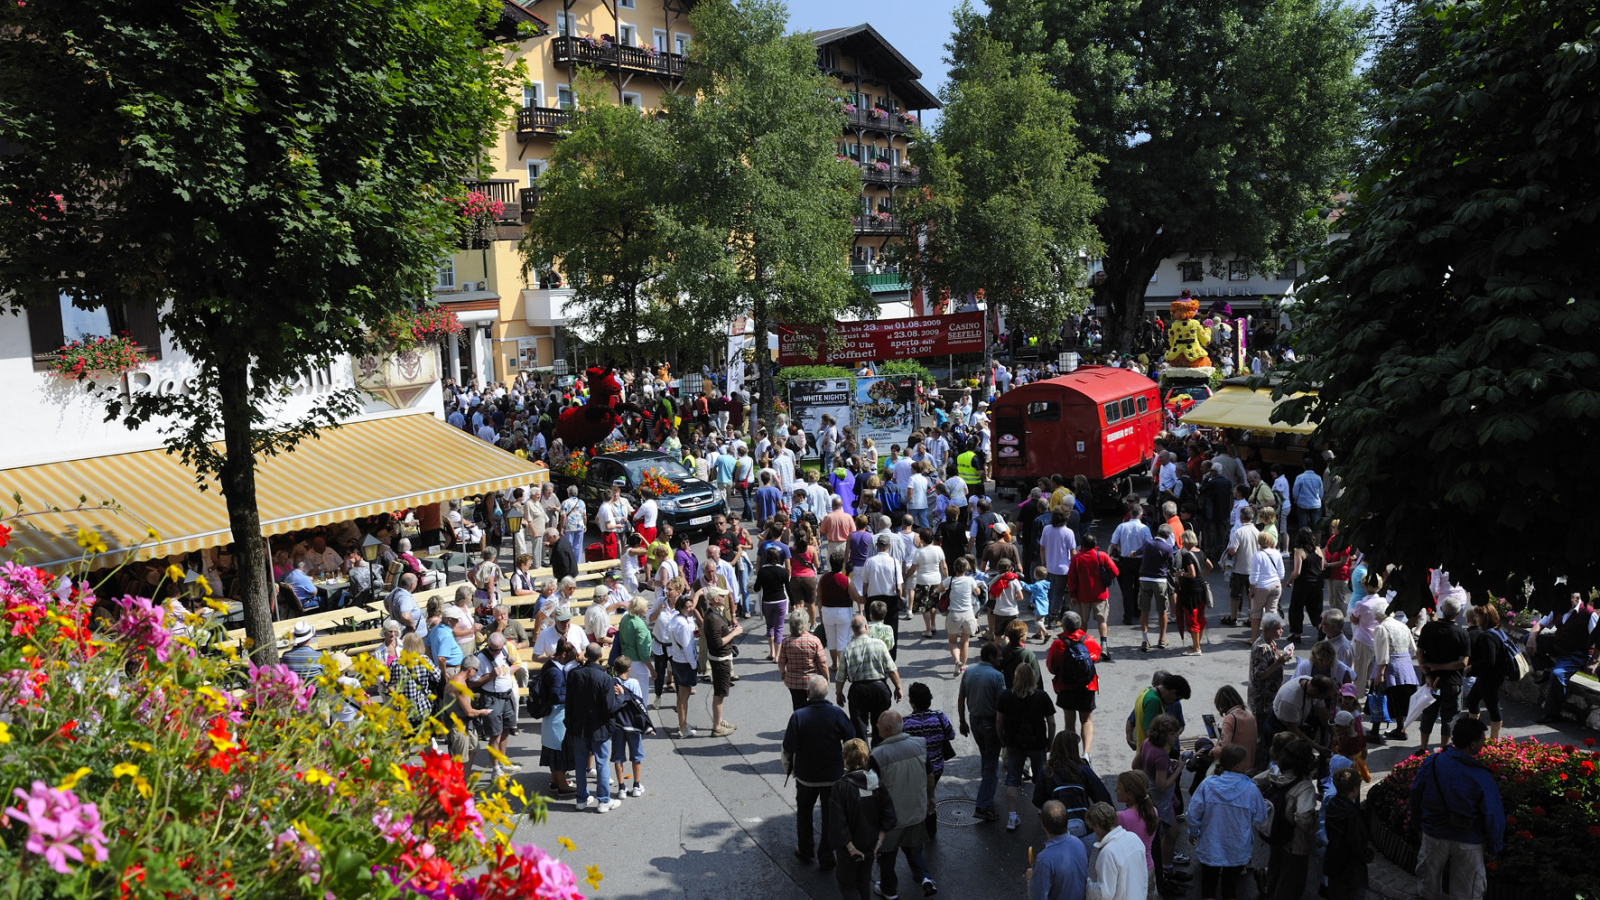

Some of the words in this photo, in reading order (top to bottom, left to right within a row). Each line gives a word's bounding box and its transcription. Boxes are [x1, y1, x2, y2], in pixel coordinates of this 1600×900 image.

[1180, 287, 1252, 297] AILER
[895, 319, 942, 330] 01.08.2009
[948, 322, 980, 332] CASINO
[894, 329, 940, 339] 23.08.2009
[948, 330, 982, 339] SEEFELD
[890, 338, 920, 348] aperto
[826, 349, 877, 362] geöffnet!
[906, 346, 932, 355] 13.00!
